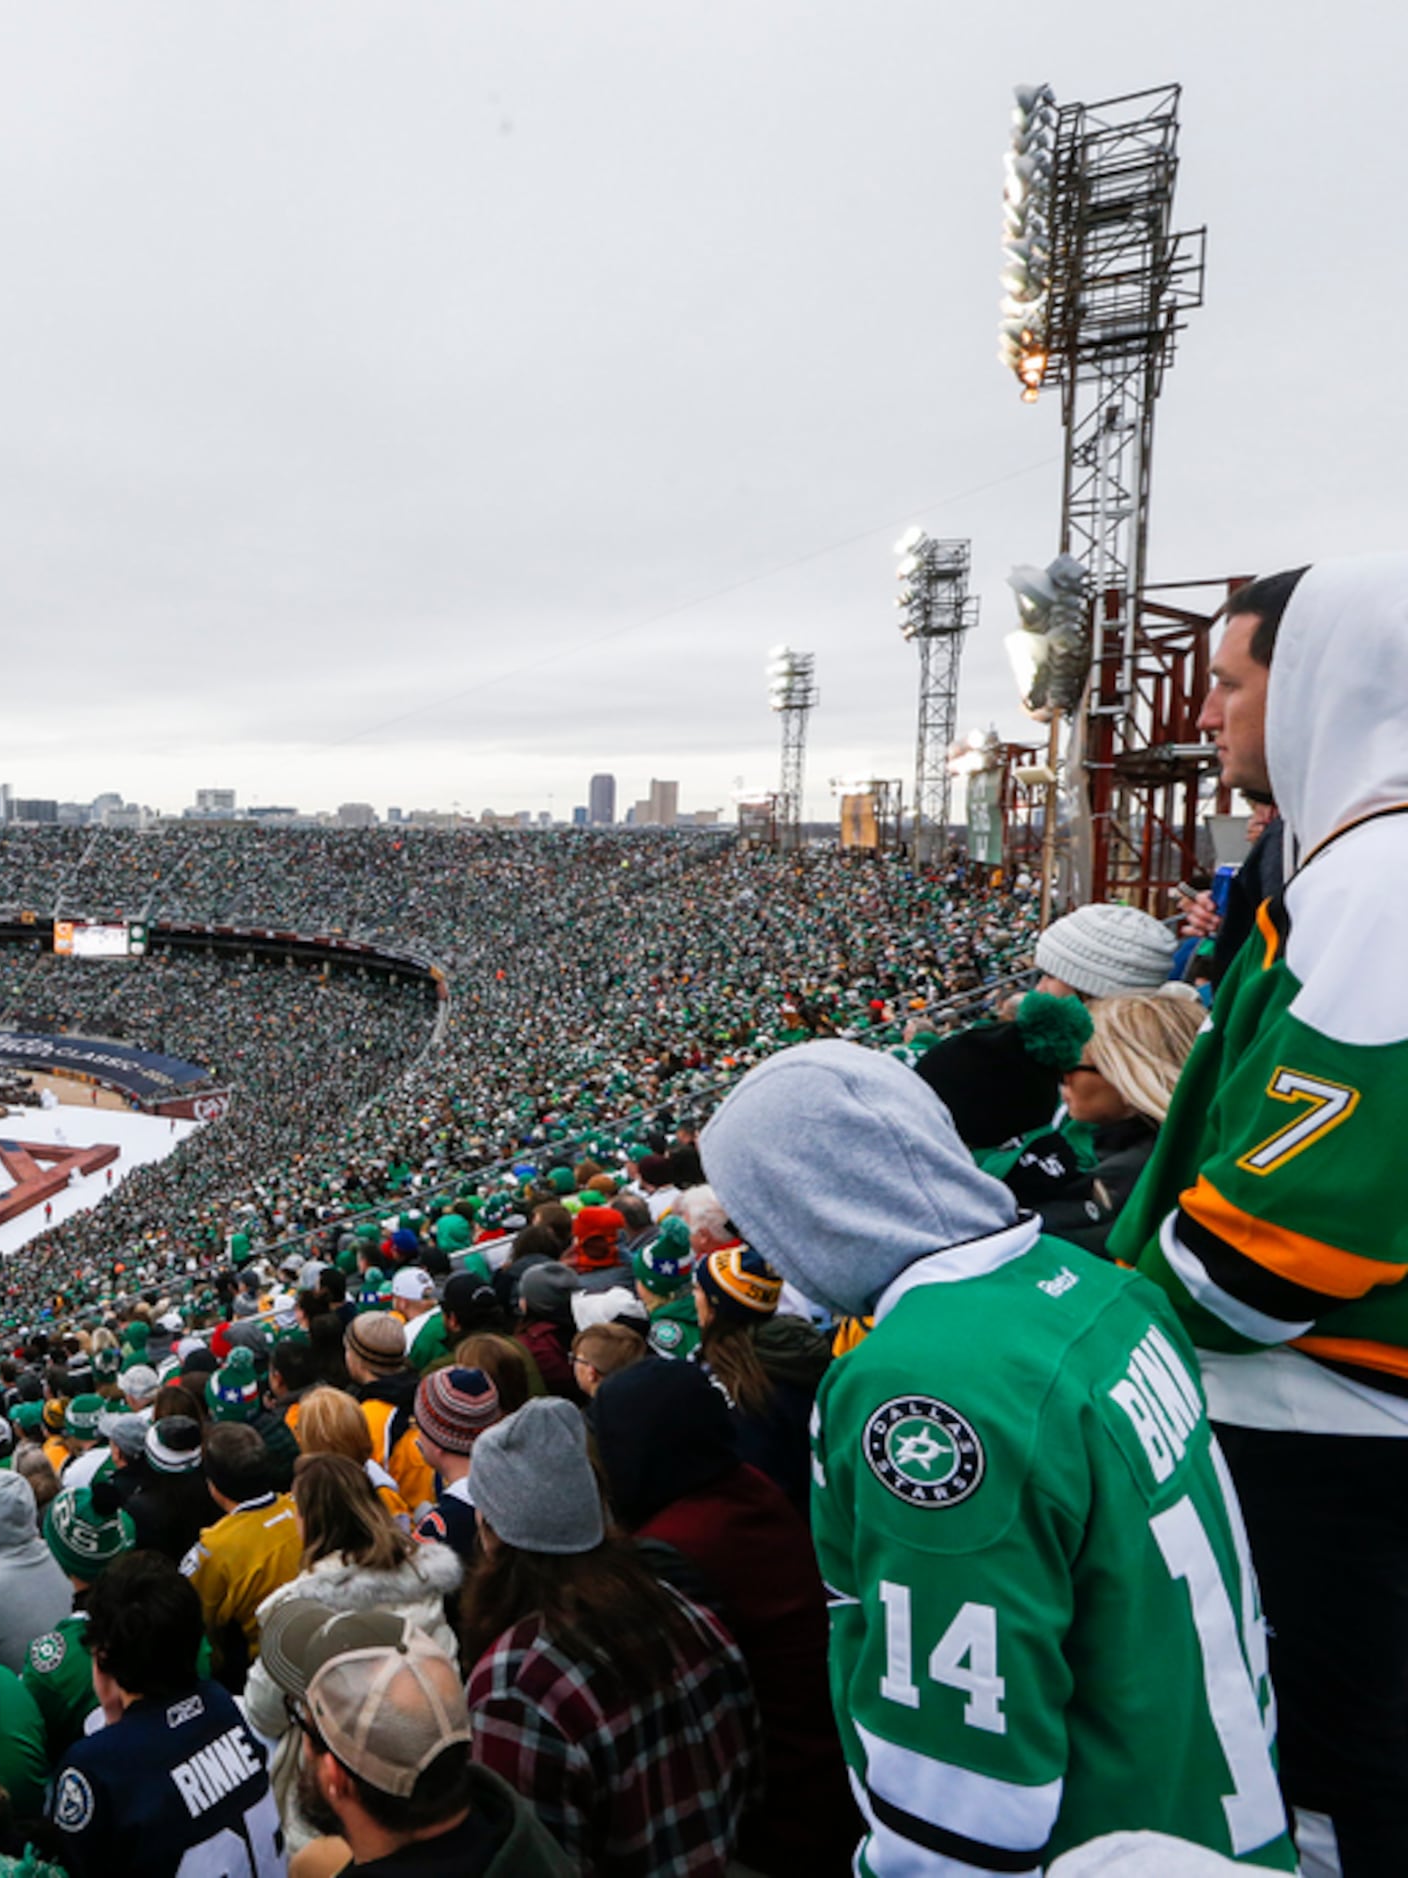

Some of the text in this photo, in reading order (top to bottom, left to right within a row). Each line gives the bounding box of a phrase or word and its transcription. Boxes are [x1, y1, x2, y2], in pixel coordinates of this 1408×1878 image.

[55, 1046, 140, 1071] CLASSIC
[1236, 1066, 1361, 1176] 7
[872, 1401, 974, 1454] DALLAS
[876, 1458, 969, 1500] STARS
[878, 1579, 1007, 1736] 14
[170, 1724, 263, 1819] RINNE
